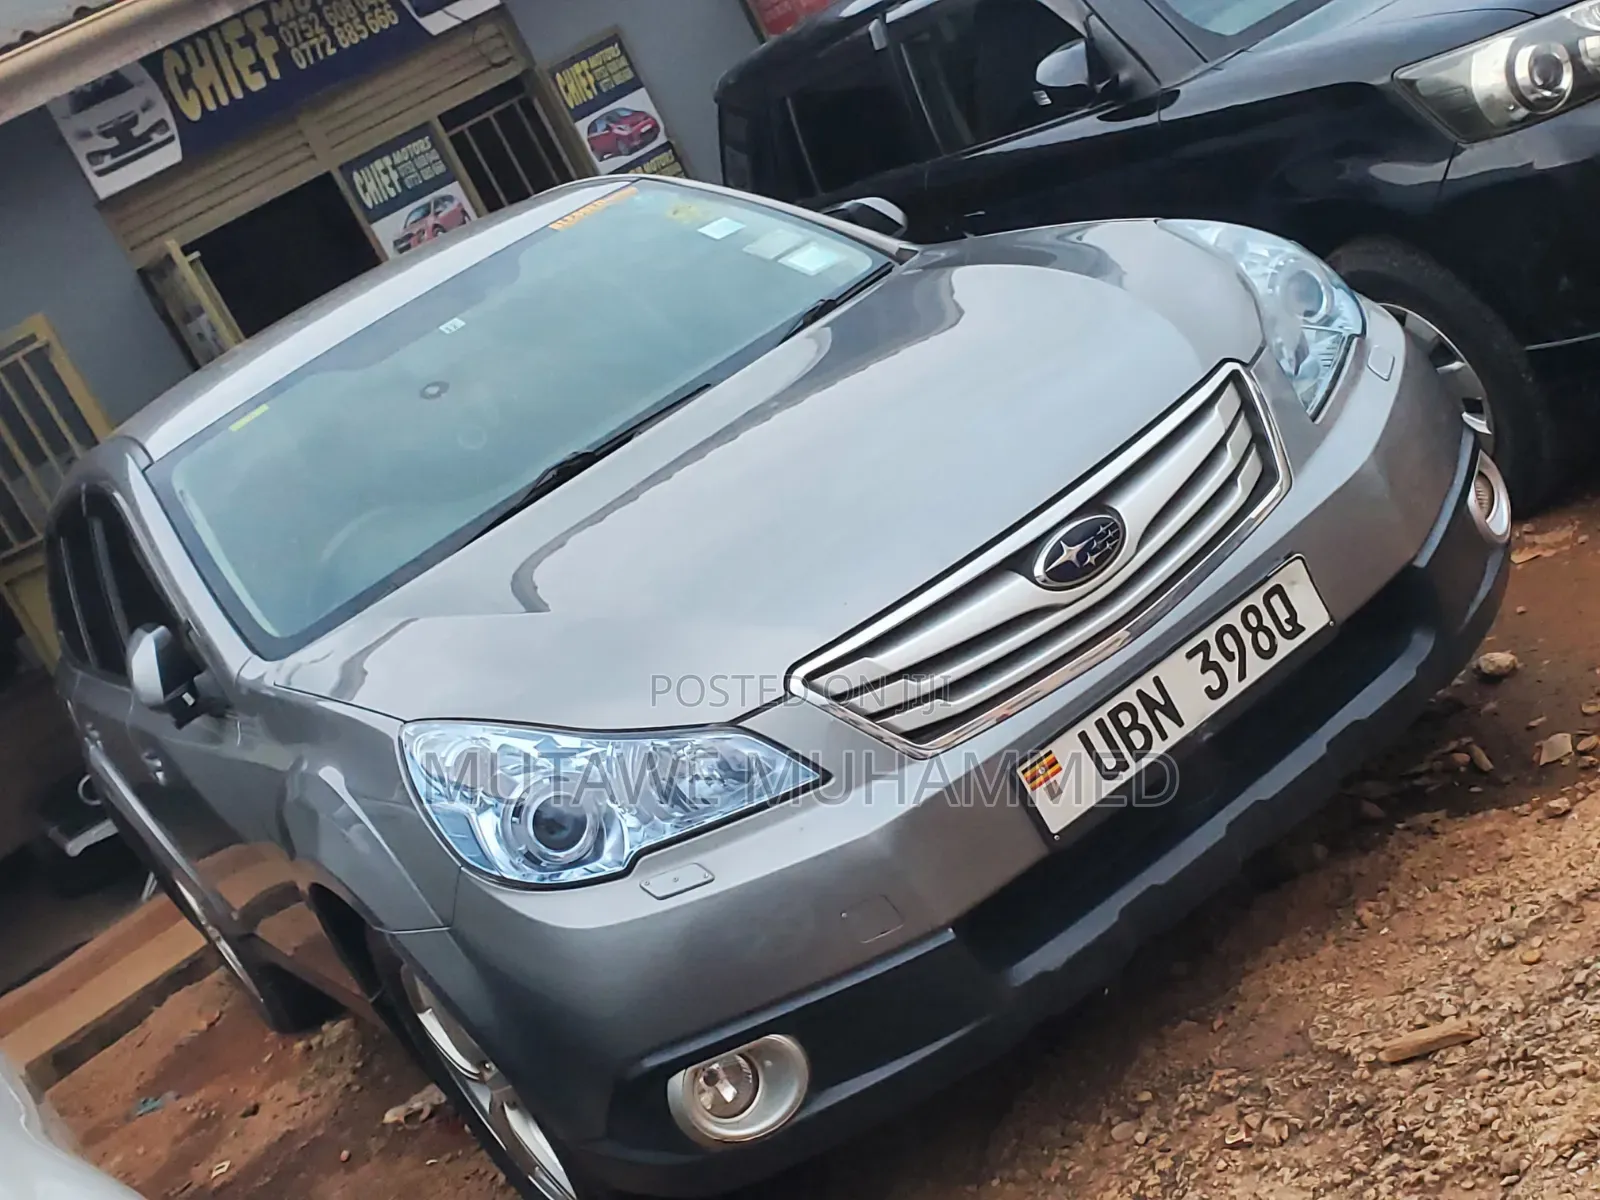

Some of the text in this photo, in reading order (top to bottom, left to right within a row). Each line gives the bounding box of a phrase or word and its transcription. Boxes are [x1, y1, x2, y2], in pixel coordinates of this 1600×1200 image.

[279, 11, 326, 47] 0752
[291, 3, 399, 69] 0772 885 666
[163, 9, 280, 121] CHIEF
[556, 60, 598, 109] CHIEF
[392, 136, 431, 165] MOTORS
[352, 155, 402, 209] CHIEF
[1077, 583, 1306, 780] UBN 398Q
